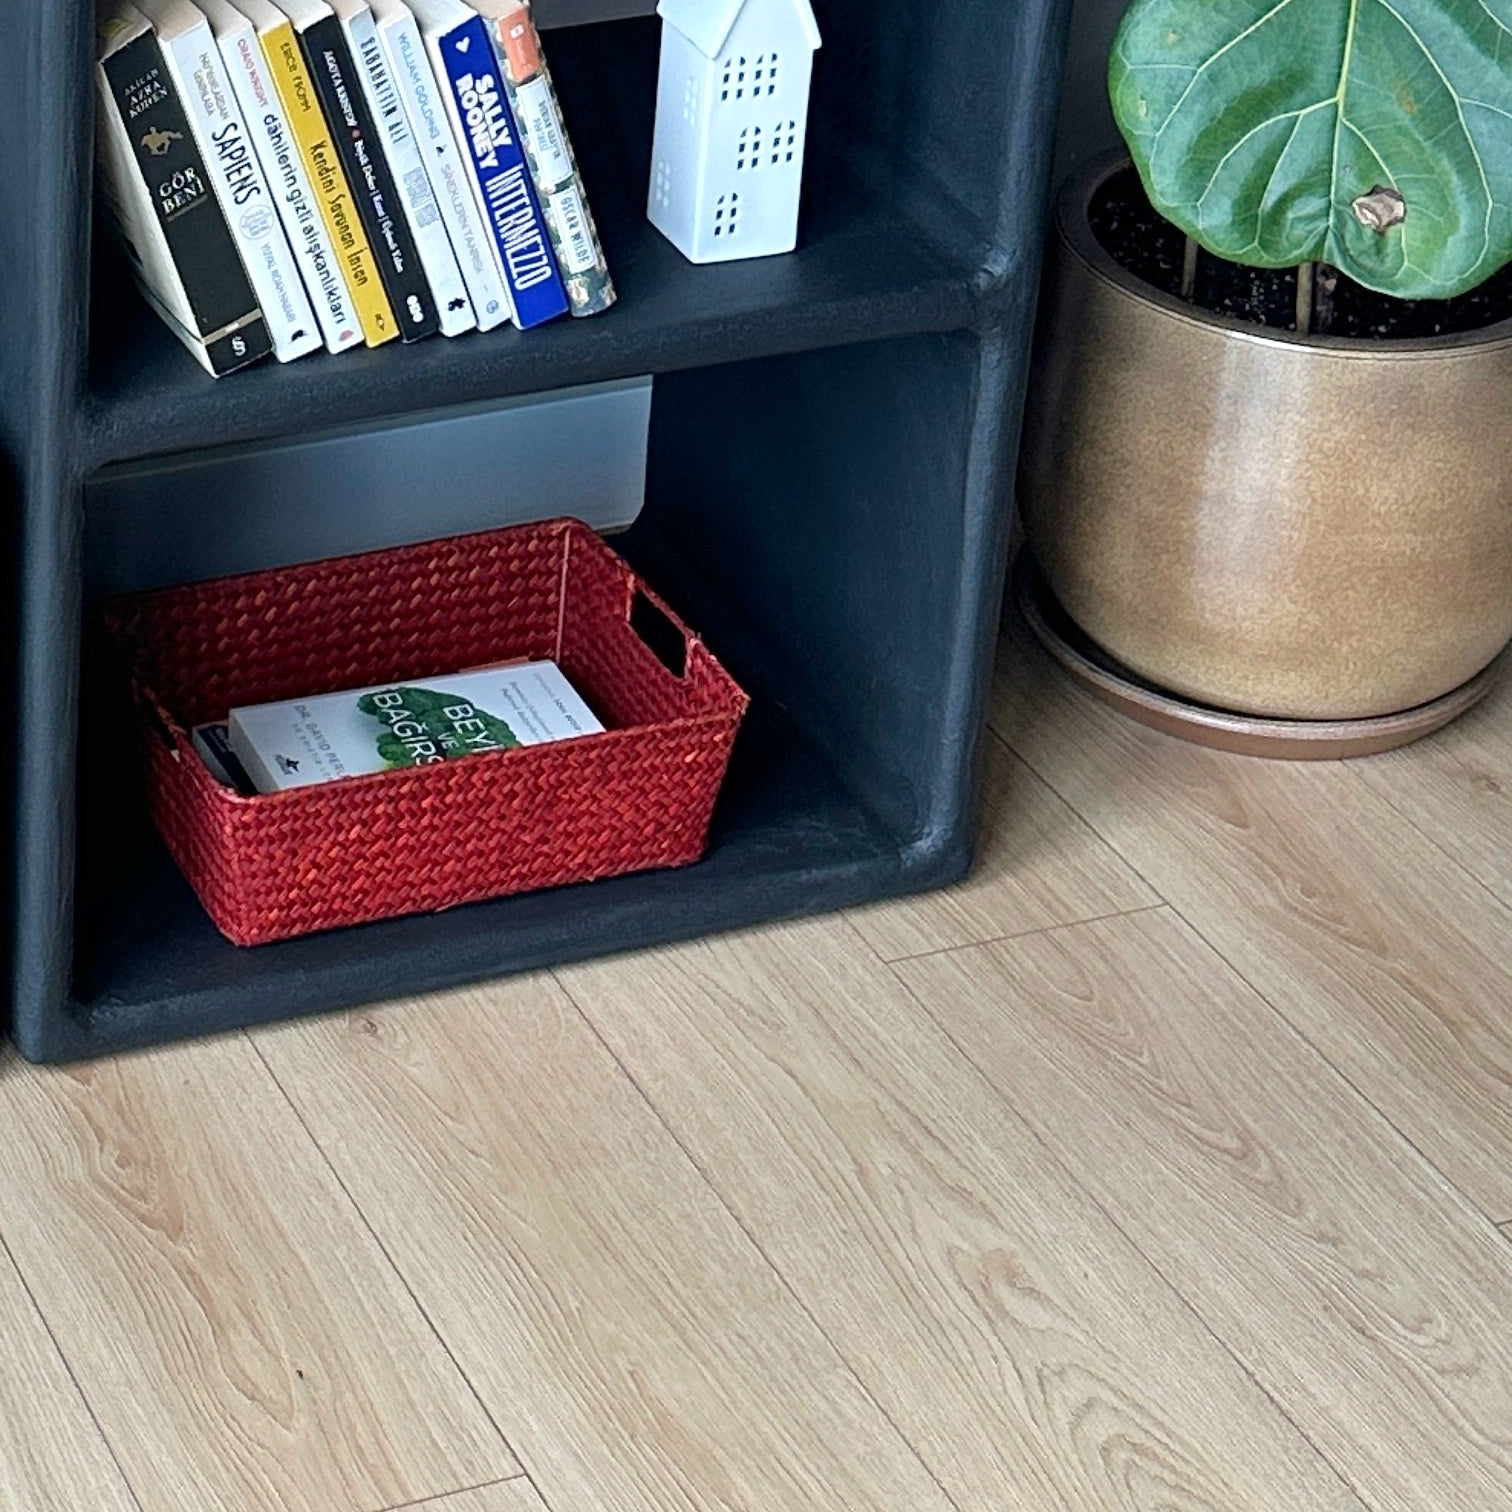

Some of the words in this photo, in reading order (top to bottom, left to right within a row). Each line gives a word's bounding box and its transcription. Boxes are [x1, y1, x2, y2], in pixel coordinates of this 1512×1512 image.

[280, 42, 298, 73] ERICH
[292, 75, 312, 113] FROMM
[322, 50, 344, 89] AGOTA
[398, 31, 422, 85] WILLIAM
[415, 83, 441, 140] GOLDING
[455, 73, 499, 169] ROONEY
[475, 73, 513, 148] SALLY
[159, 166, 196, 198] GÖR
[212, 122, 261, 205] SAPIENS
[310, 140, 337, 194] Kendini
[328, 193, 356, 249] Savunan
[347, 246, 369, 287] İnsan
[485, 162, 552, 291] INTERMEZZO
[560, 196, 580, 229] OSCAR
[571, 229, 591, 264] WILDE
[285, 187, 314, 225] gizli
[302, 224, 347, 324] alışkanlıkları
[437, 731, 460, 750] VE
[443, 703, 505, 752] BEYİ
